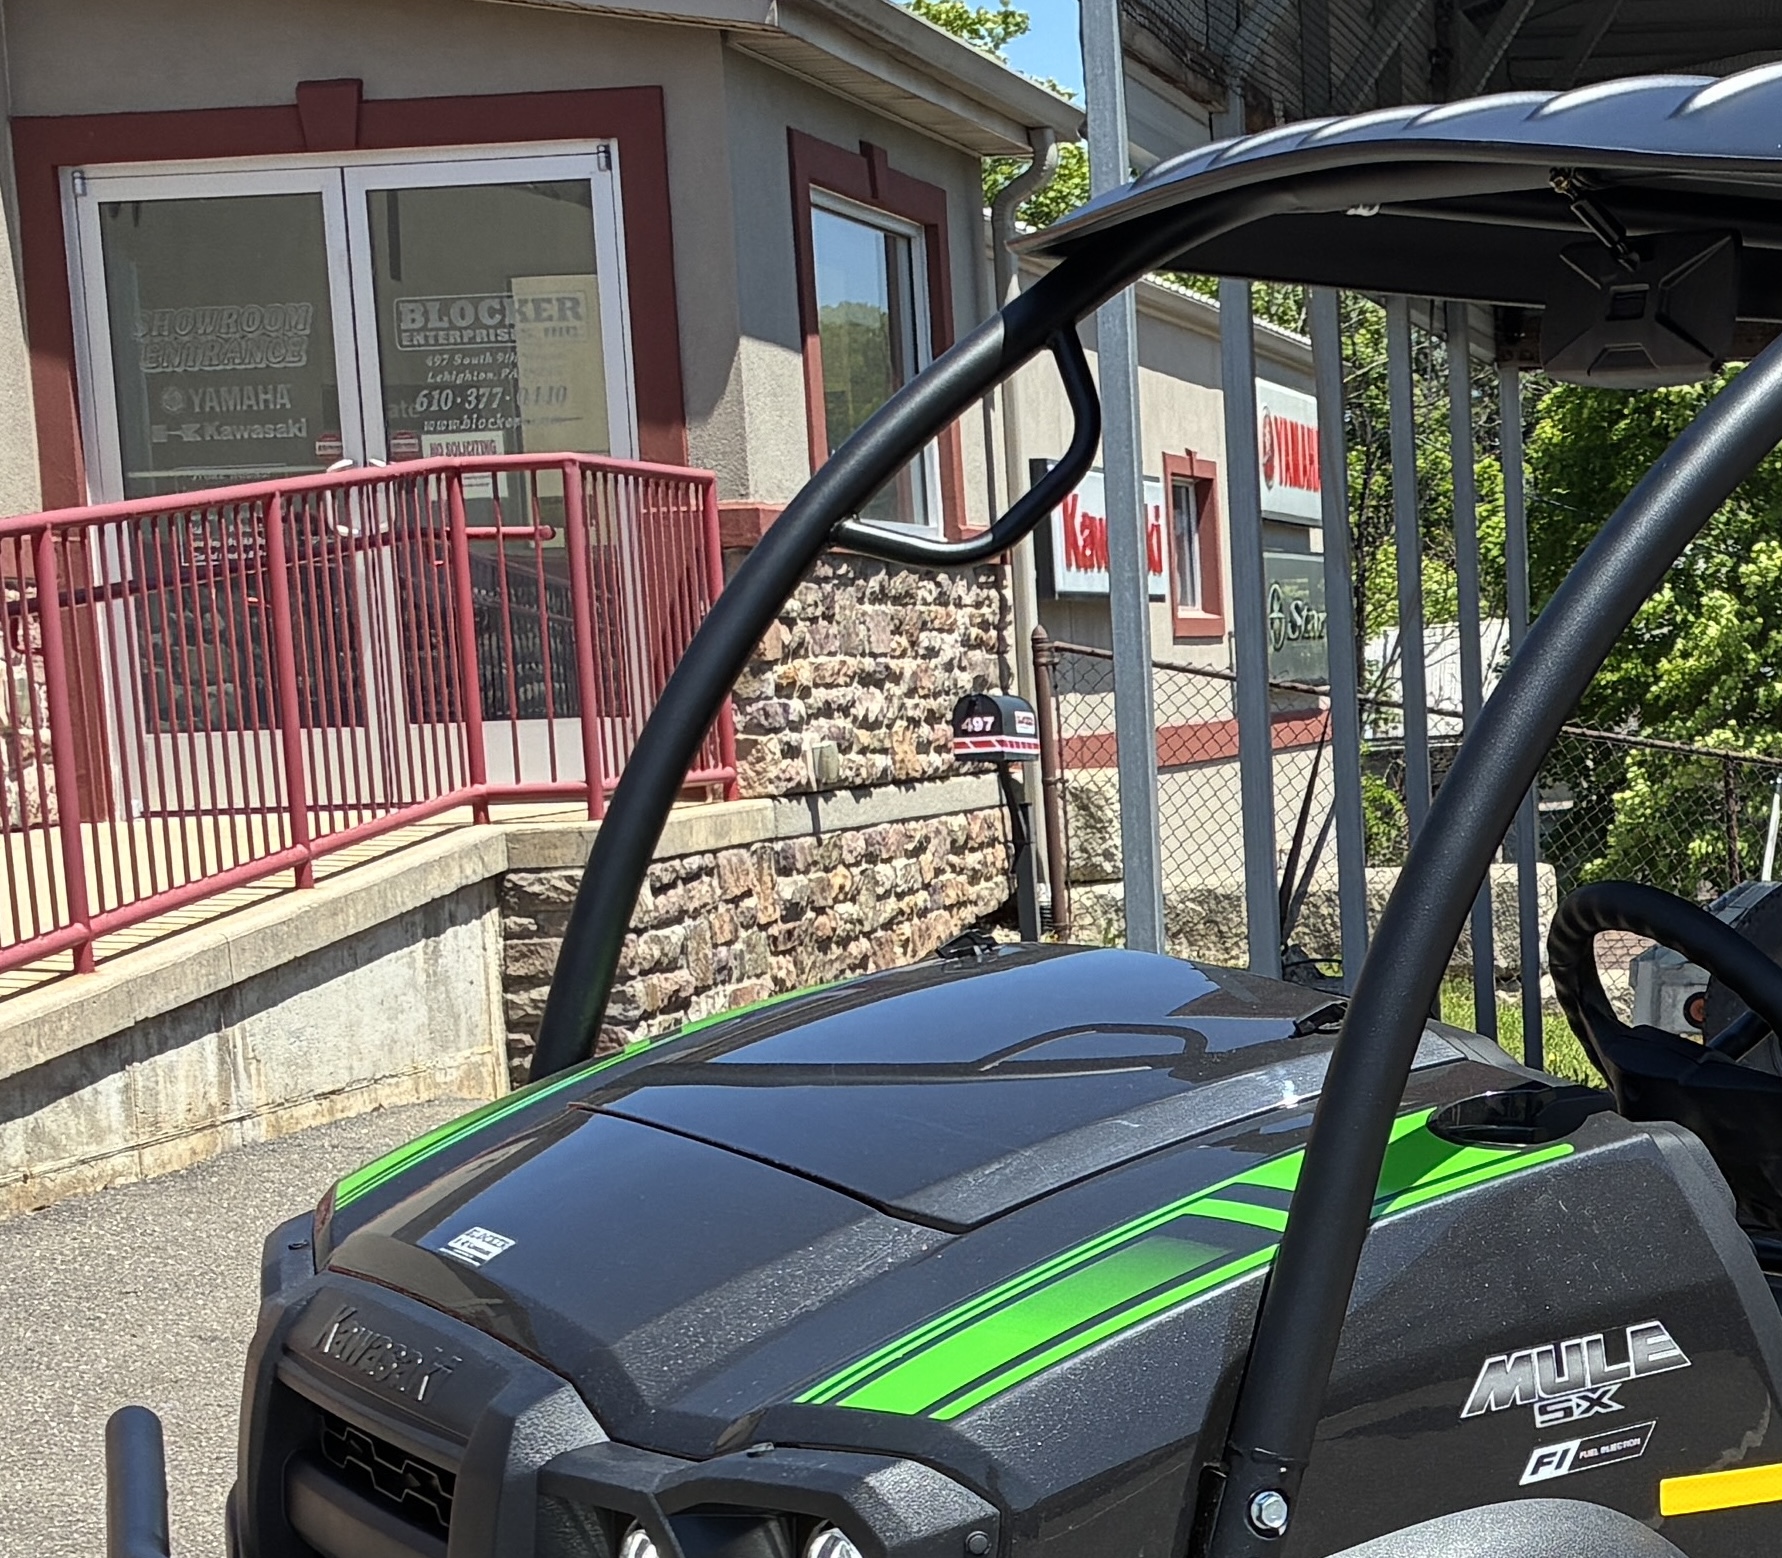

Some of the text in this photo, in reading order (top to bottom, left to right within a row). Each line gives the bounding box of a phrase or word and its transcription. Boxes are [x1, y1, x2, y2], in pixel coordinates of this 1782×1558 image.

[400, 296, 583, 330] BLOCKER
[141, 335, 308, 372] ENTRANCE
[453, 351, 493, 366] South
[189, 384, 293, 412] YAMAHA
[204, 418, 307, 440] Kawasaki
[1273, 414, 1321, 492] YAMAH
[961, 716, 995, 733] 497
[311, 1302, 464, 1406] Kawasaki
[1459, 1319, 1693, 1420] MULE
[1533, 1382, 1626, 1429] SX
[1528, 1447, 1572, 1477] FI
[1578, 1447, 1600, 1460] FUEL
